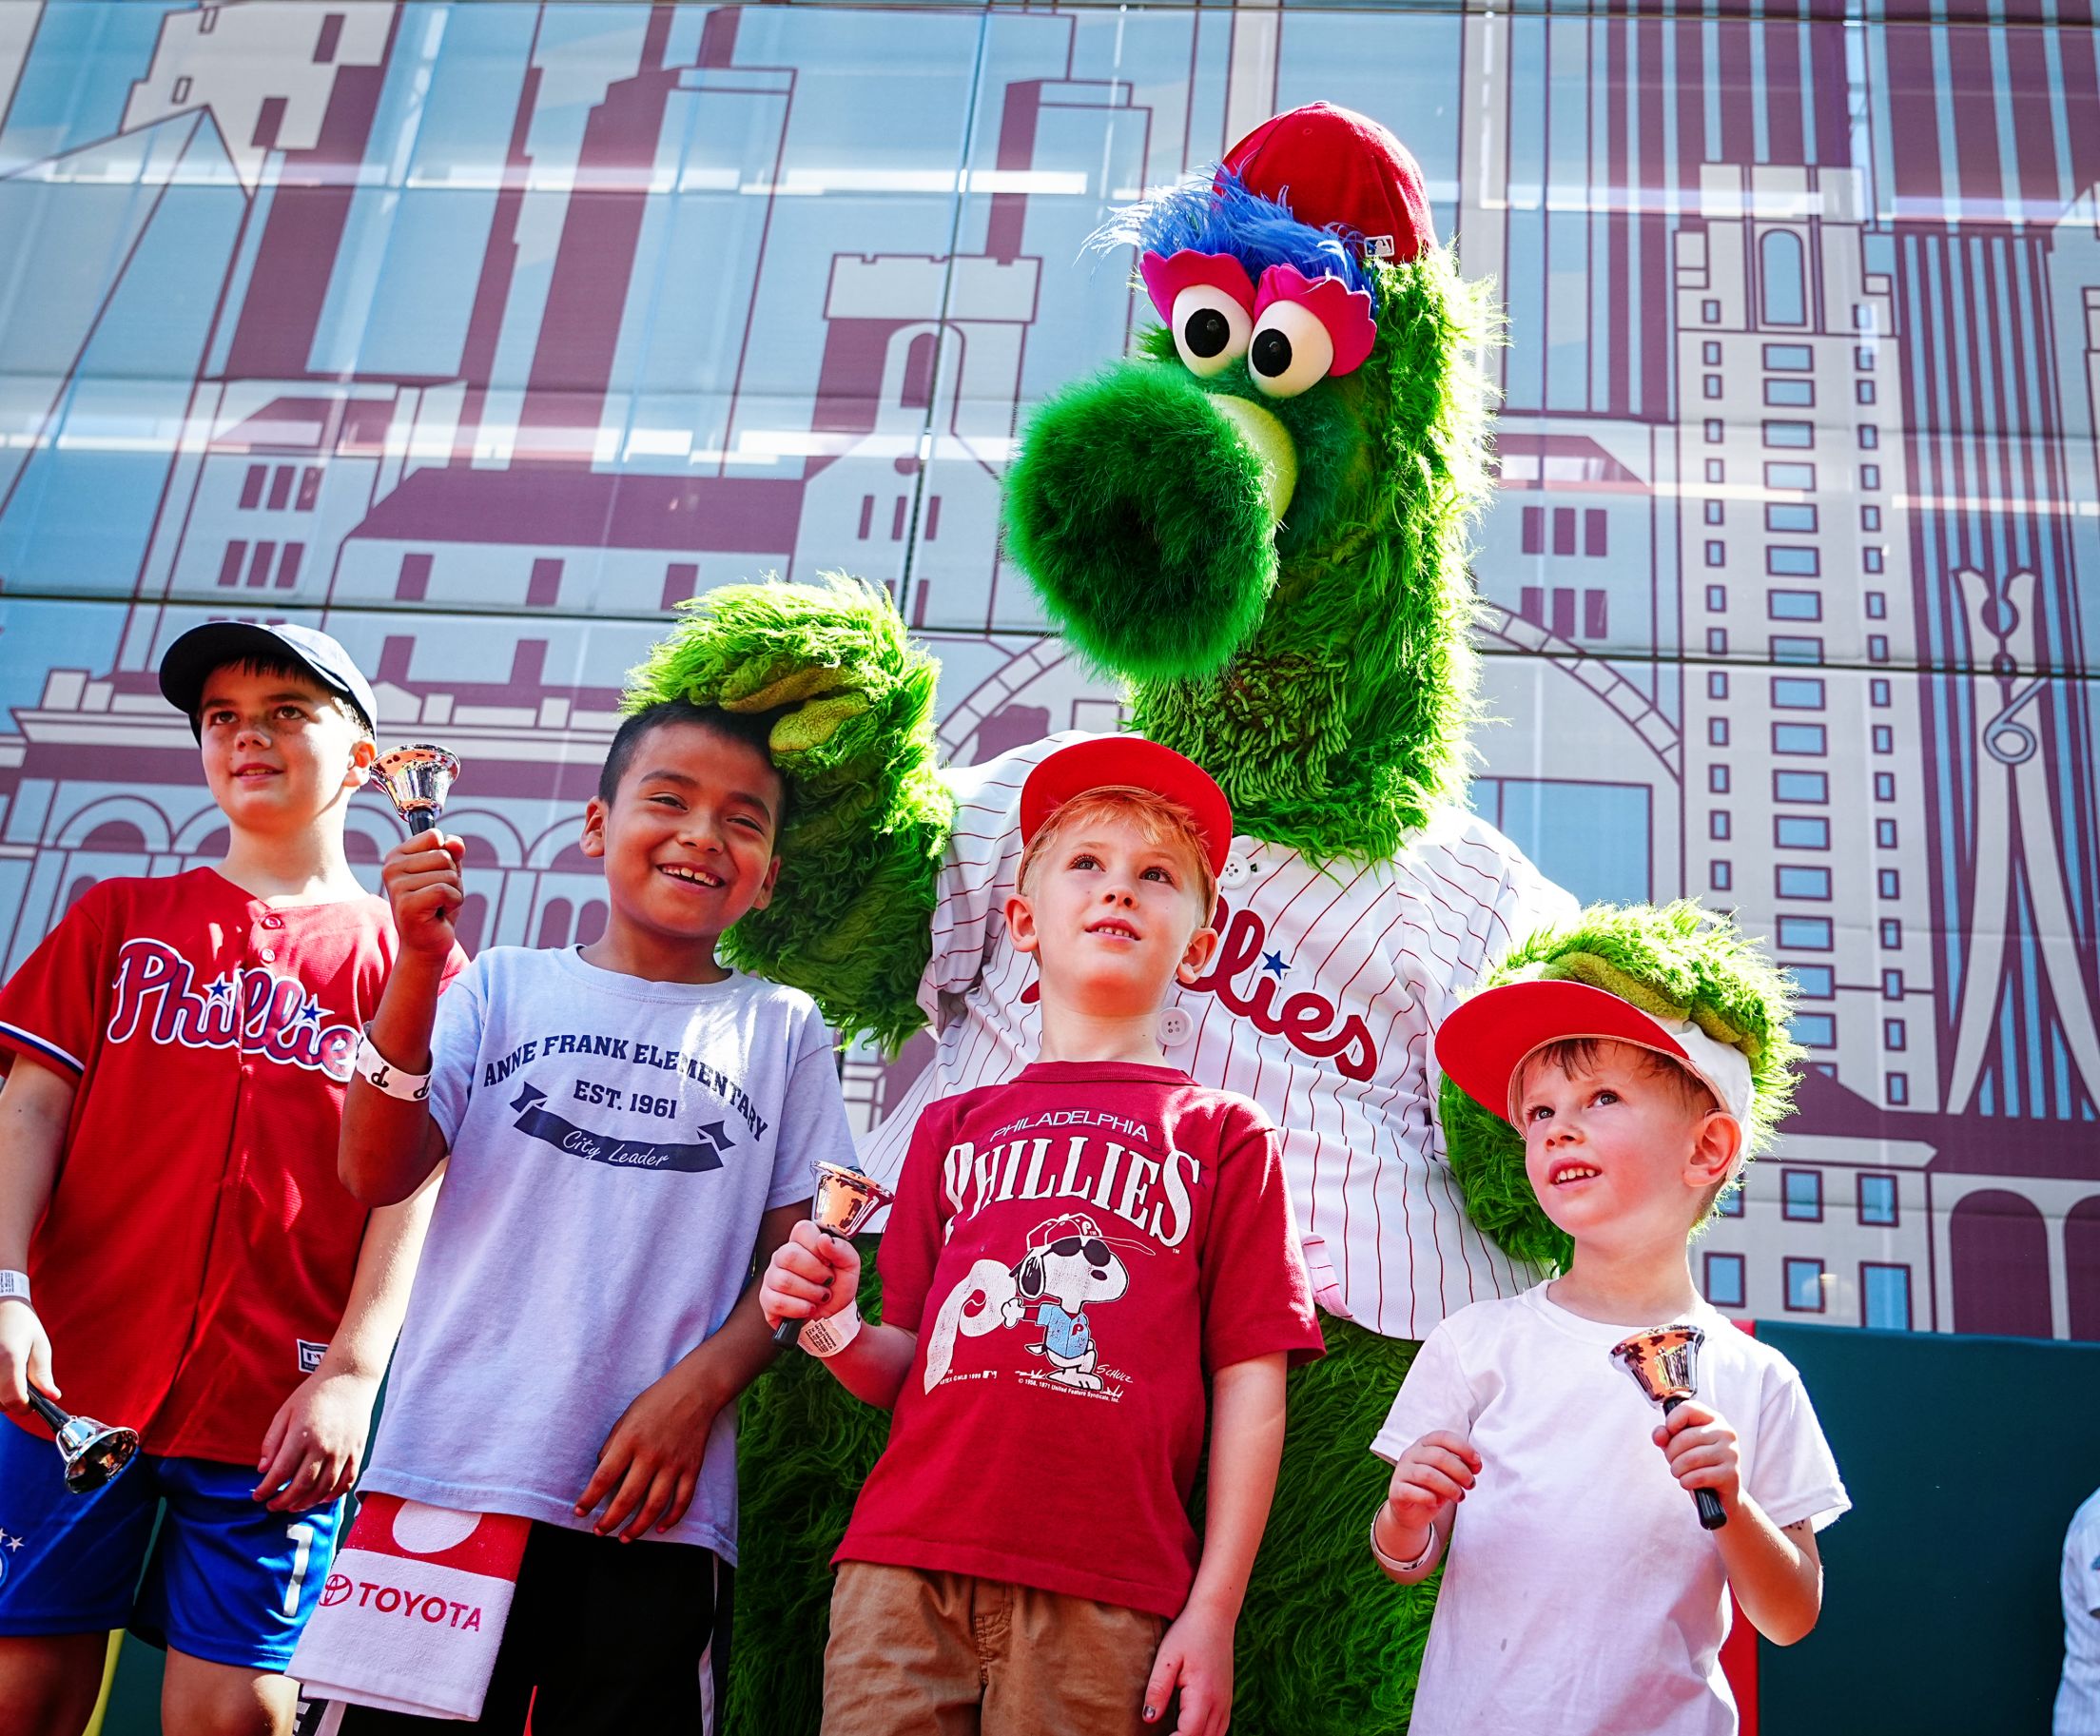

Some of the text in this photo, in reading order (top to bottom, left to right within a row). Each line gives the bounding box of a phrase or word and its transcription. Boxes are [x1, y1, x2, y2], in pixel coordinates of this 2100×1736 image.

[107, 937, 360, 1083] Phillie
[483, 1034, 768, 1141] ANNE FRANK ELEMENTARY
[574, 1079, 677, 1119] EST. 1961
[562, 1129, 670, 1166] City Leader
[989, 1110, 1149, 1142] PHILADELPHIA
[943, 1136, 1200, 1248] PHILLIES
[924, 1258, 1018, 1395] P
[1051, 1384, 1067, 1393] United
[1068, 1388, 1086, 1396] Feature
[1096, 1364, 1134, 1383] SCHULZ
[358, 1581, 481, 1633] TOYOTA
